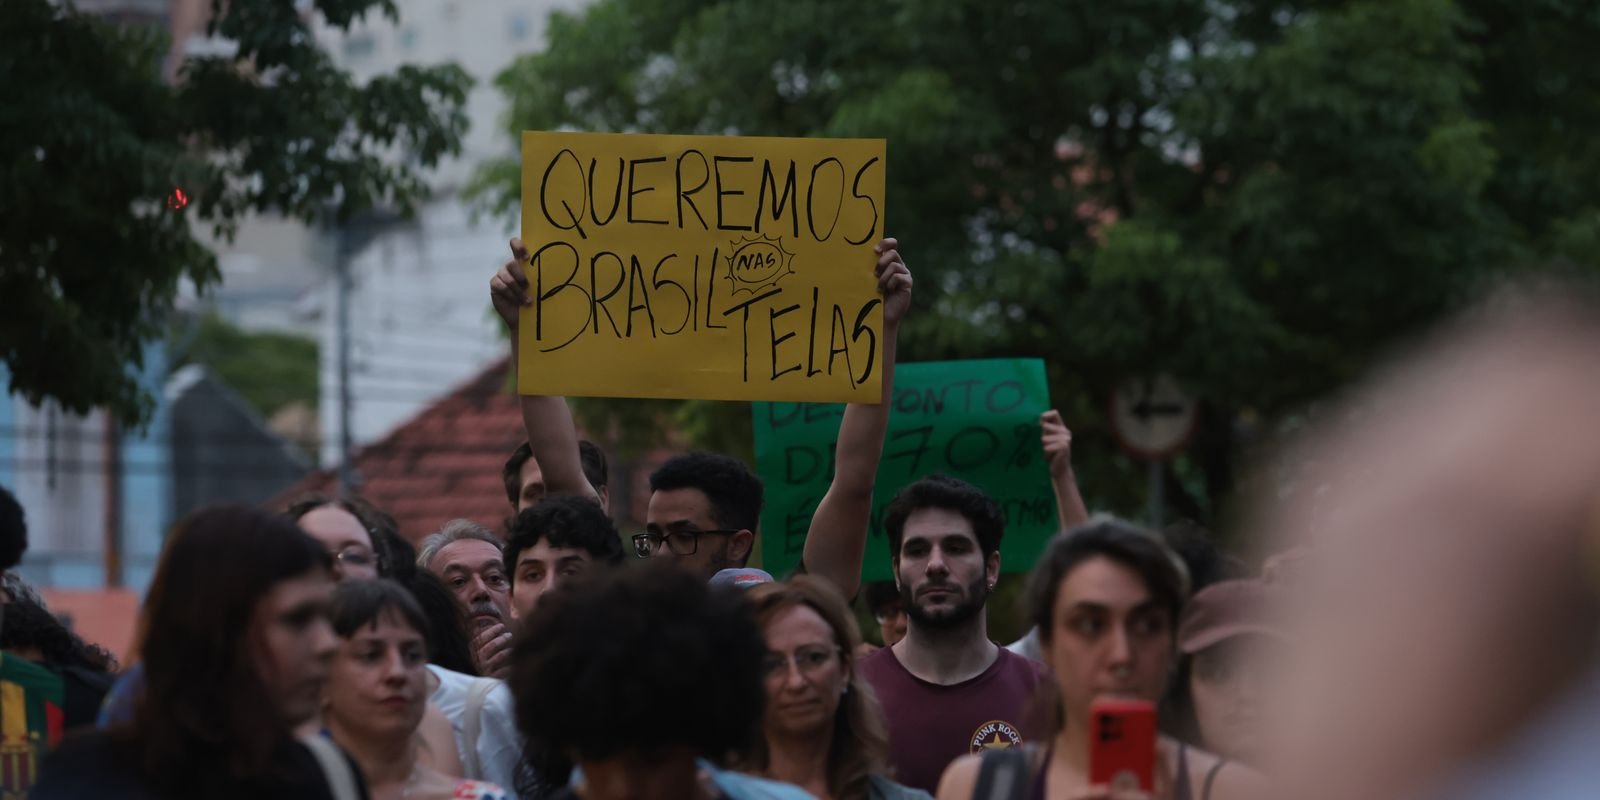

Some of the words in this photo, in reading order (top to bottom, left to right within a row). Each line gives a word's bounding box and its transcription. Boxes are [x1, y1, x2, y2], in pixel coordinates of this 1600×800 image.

[540, 149, 879, 245] QUEREMOS
[530, 241, 727, 352] BRASIL
[736, 254, 776, 272] NAS
[723, 287, 882, 389] TELAS
[768, 378, 1026, 428] DEONTO
[888, 423, 1036, 475] 70%
[974, 724, 997, 747] PUNK
[998, 723, 1021, 744] ROCK
